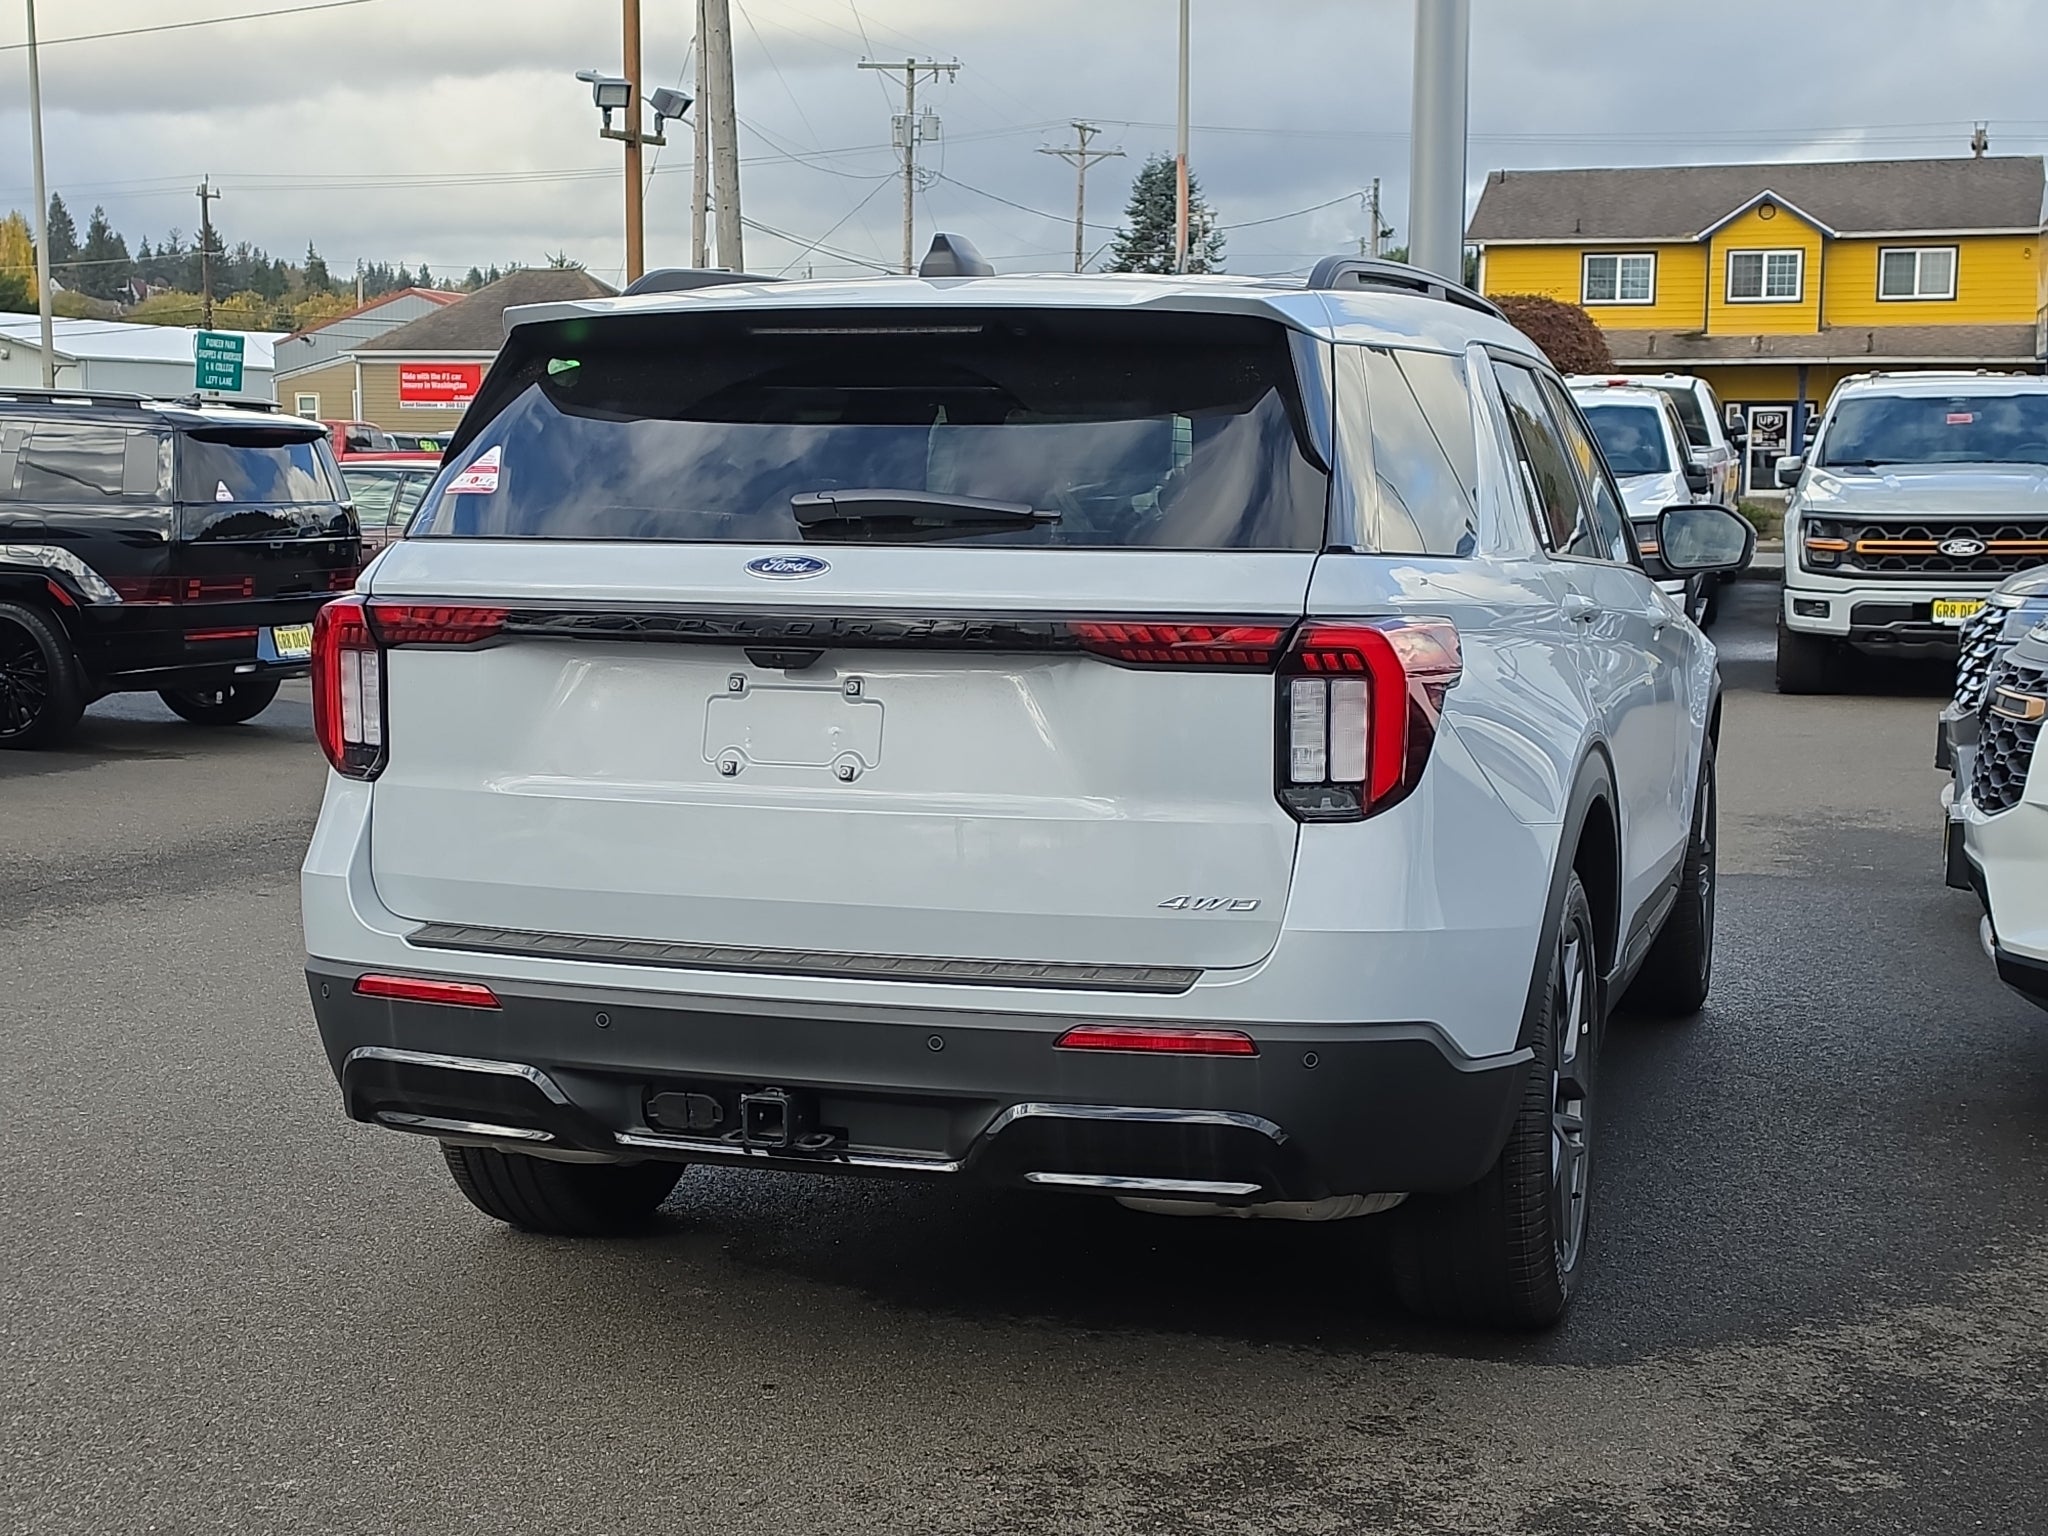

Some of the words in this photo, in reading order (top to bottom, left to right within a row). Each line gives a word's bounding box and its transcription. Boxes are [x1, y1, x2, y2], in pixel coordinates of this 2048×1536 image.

[205, 338, 224, 348] PIONEER
[225, 340, 236, 349] PARK
[215, 363, 234, 373] COLLEGE
[205, 375, 218, 384] LEFT
[219, 377, 232, 386] LANE
[417, 372, 430, 380] with
[430, 372, 440, 380] the
[431, 381, 467, 391] Washington
[1759, 415, 1780, 425] UPX
[762, 557, 812, 572] Ford
[1936, 604, 1956, 618] GR8
[1960, 604, 1980, 618] DEA
[569, 613, 994, 644] EXPLORER
[277, 632, 292, 650] GR8
[1157, 894, 1262, 912] 4WD
